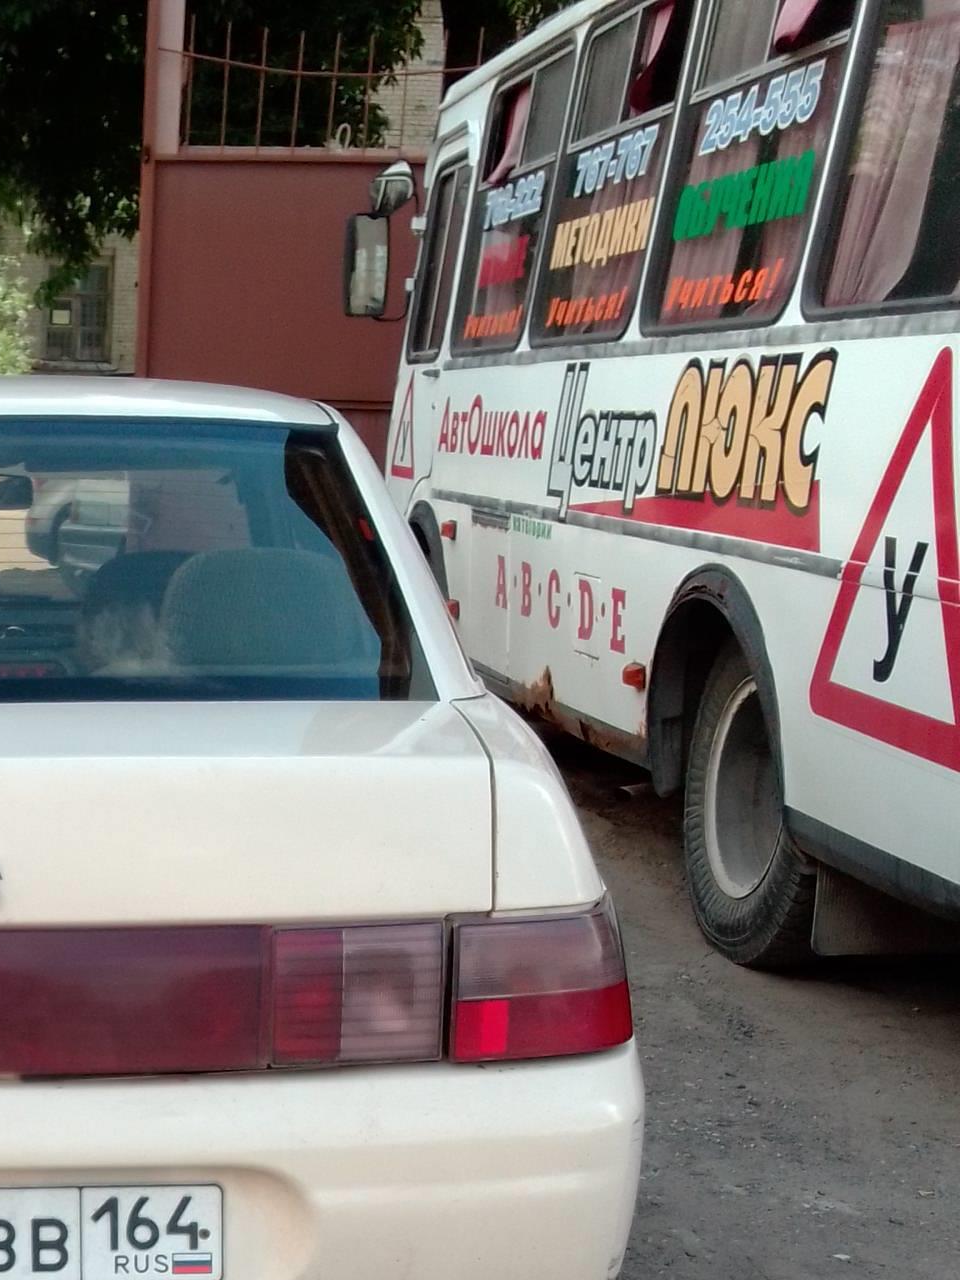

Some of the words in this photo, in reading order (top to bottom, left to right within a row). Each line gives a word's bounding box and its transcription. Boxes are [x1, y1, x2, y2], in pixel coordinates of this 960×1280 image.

[698, 57, 826, 156] 254-555
[549, 197, 656, 270] МЕТОДИКИ
[673, 145, 815, 241] ОБУЧЕНИЯ
[546, 362, 659, 523] Центр
[655, 347, 839, 514] ЛЮКС
[91, 1195, 200, 1251] 164
[114, 1255, 168, 1274] RUS
